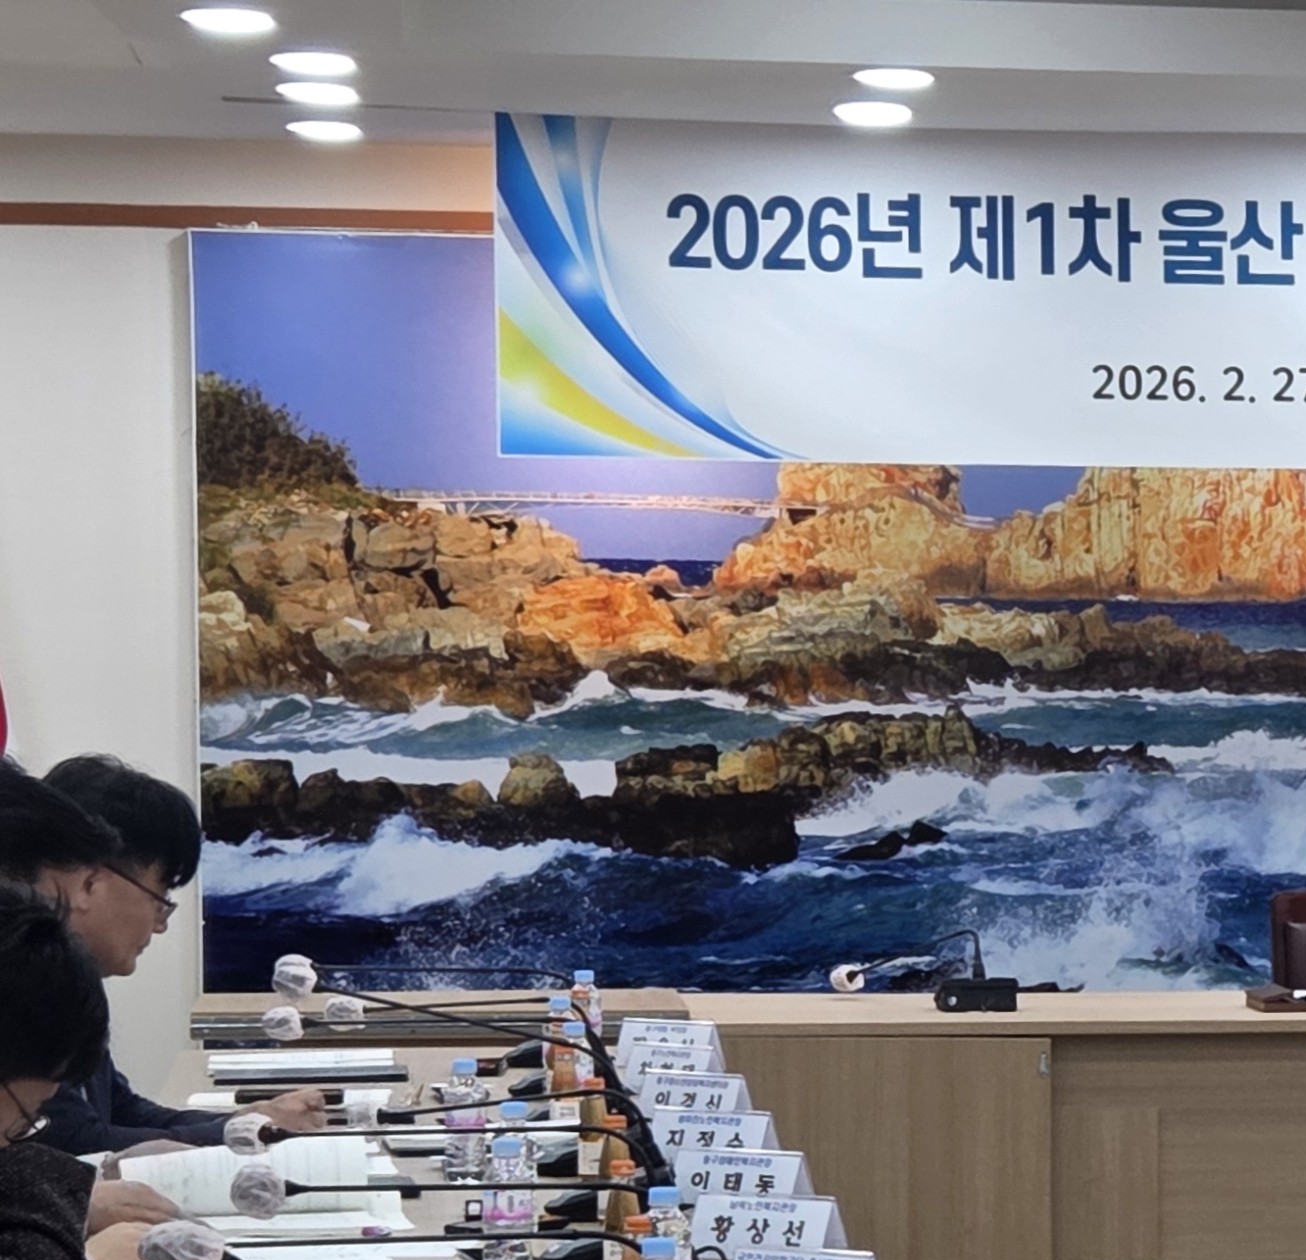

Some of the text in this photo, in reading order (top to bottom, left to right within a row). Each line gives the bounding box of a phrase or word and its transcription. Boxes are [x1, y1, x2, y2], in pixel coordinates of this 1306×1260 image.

[667, 192, 924, 280] 2026년
[949, 194, 1142, 283] 제1차
[1158, 199, 1304, 288] 울산
[1092, 364, 1207, 403] 2026.
[1223, 366, 1257, 404] 2.
